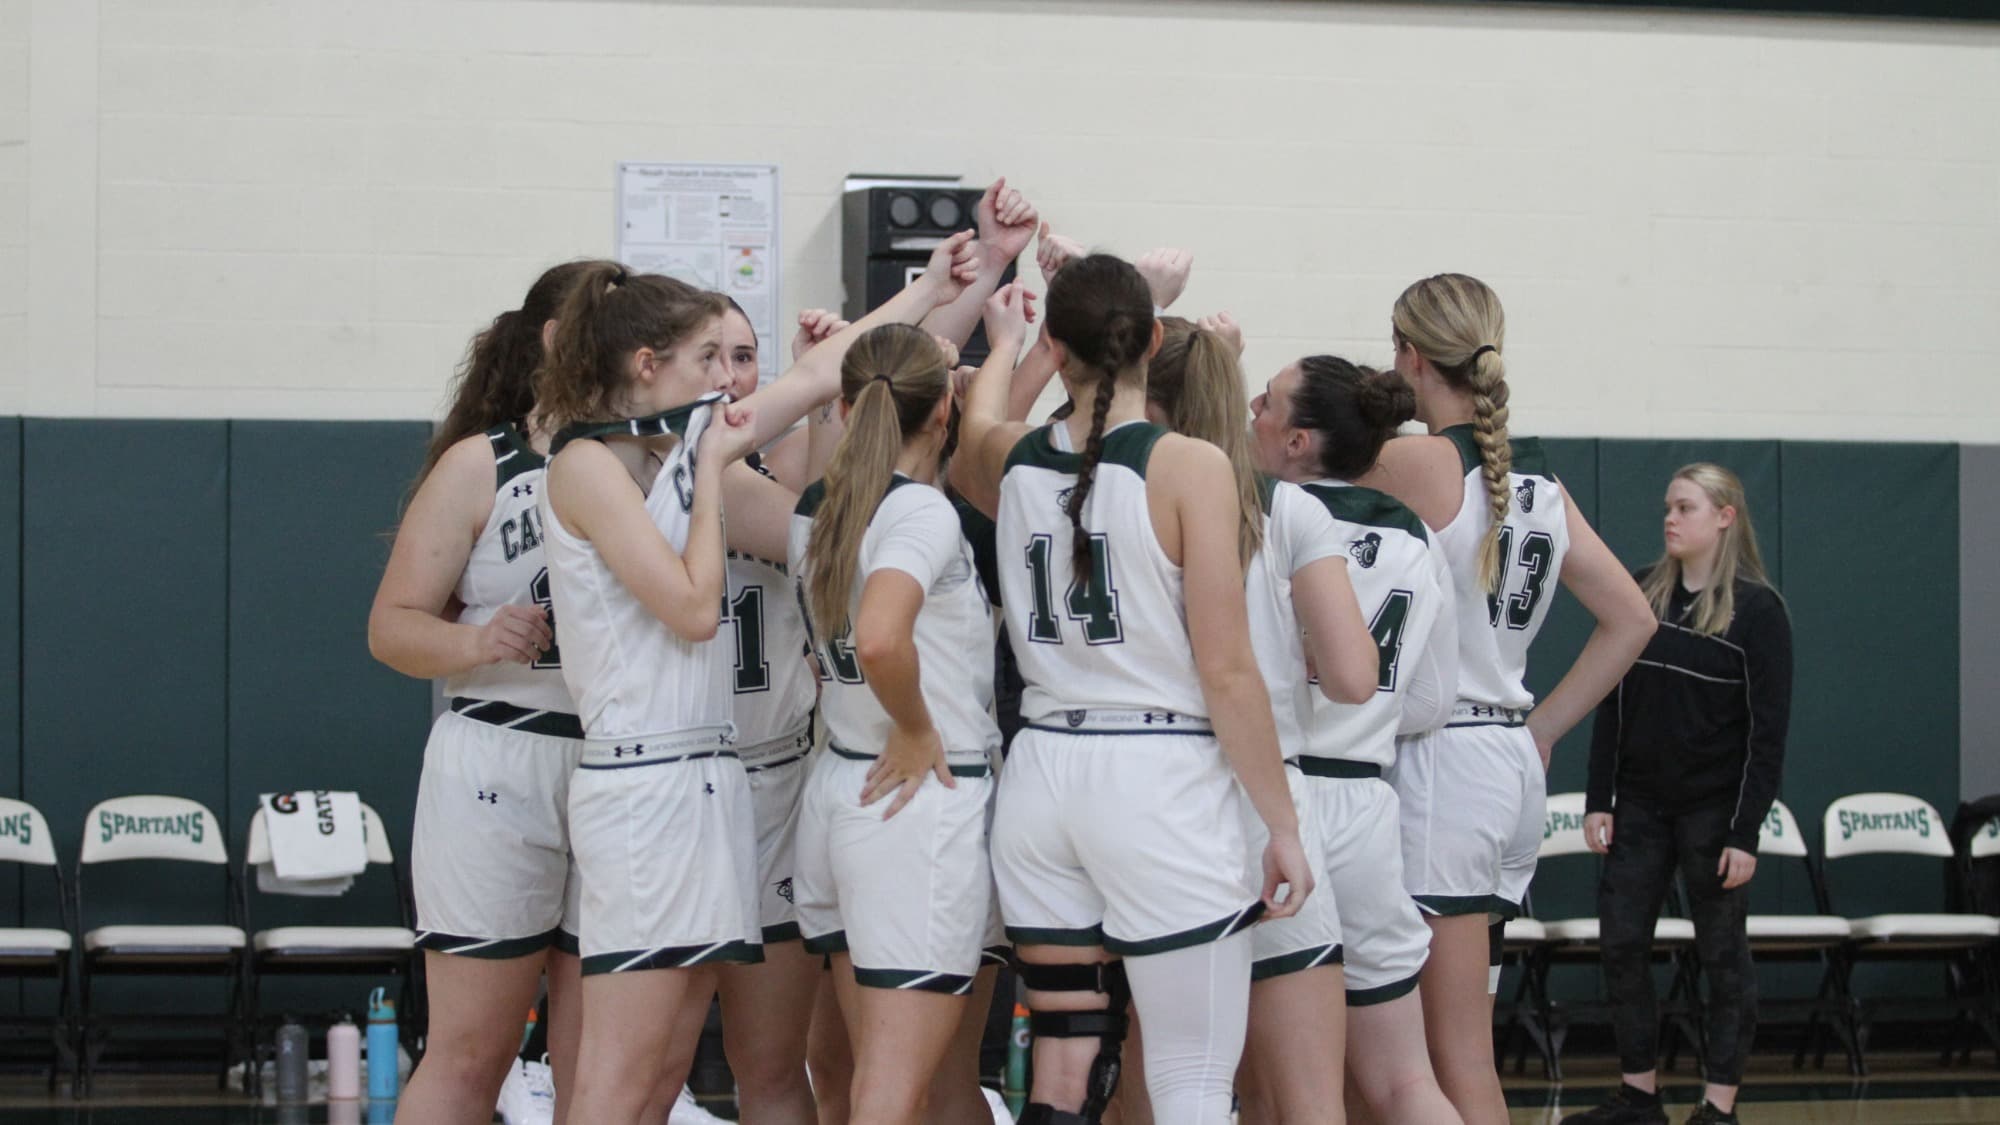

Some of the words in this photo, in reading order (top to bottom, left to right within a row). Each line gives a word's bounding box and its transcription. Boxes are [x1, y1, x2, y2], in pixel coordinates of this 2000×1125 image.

[500, 505, 545, 563] CA
[1024, 532, 1125, 646] 14
[1487, 525, 1554, 630] 13
[0, 812, 32, 845] NS
[100, 810, 204, 844] SPARTANS
[1838, 806, 1931, 840] SPARTANS
